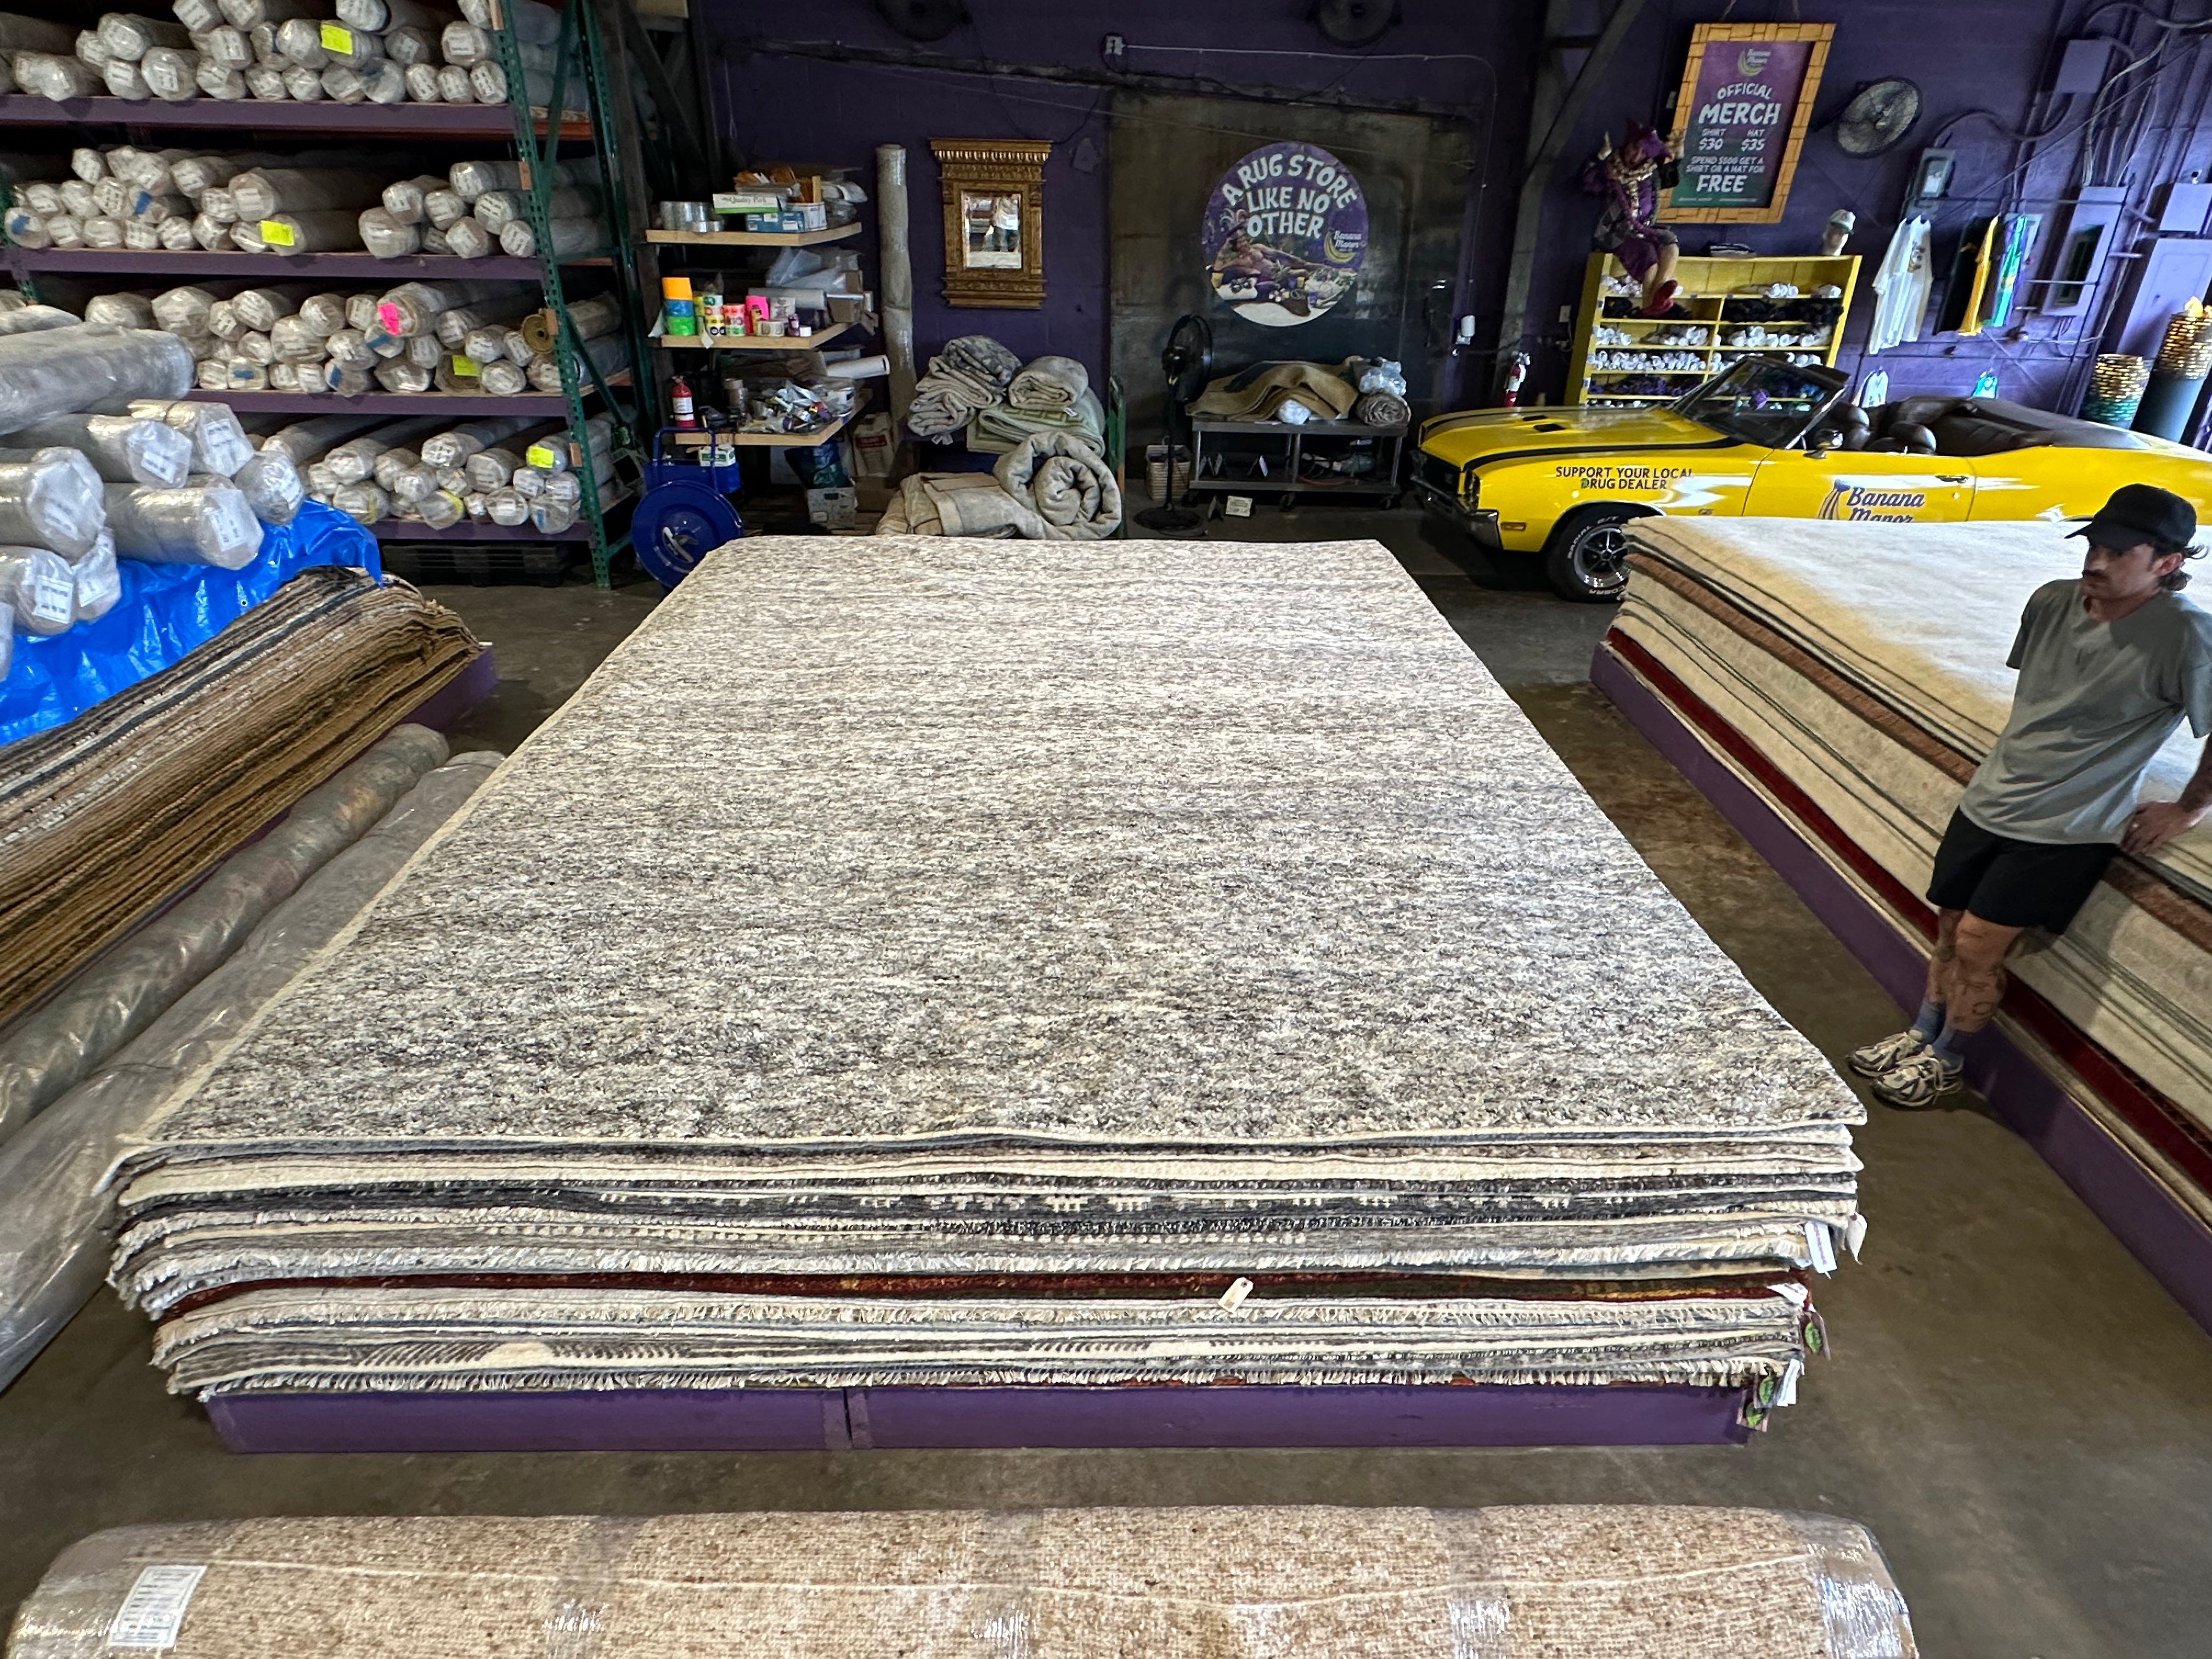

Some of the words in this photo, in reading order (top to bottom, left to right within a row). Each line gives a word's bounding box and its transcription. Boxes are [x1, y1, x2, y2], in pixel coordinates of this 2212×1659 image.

[1717, 82, 1773, 100] OFFICIAL
[1699, 102, 1782, 125] MERCH
[1699, 138, 1723, 150] $30
[1741, 138, 1765, 151] $35
[1691, 156, 1717, 165] SPEND
[1222, 183, 1244, 206] A
[1238, 153, 1283, 189] RUG
[1288, 154, 1358, 209] STORE
[1696, 174, 1748, 193] FREE
[1246, 187, 1293, 213] LIKE
[1296, 188, 1331, 214] NO
[1247, 211, 1324, 239] OTHER
[1556, 467, 1612, 477] SUPPORT
[1616, 467, 1650, 478] YOUR
[1654, 468, 1692, 478] LOCAL
[1581, 478, 1615, 489] DRUG
[1618, 478, 1667, 489] DEALER
[1847, 487, 1926, 507] Banana
